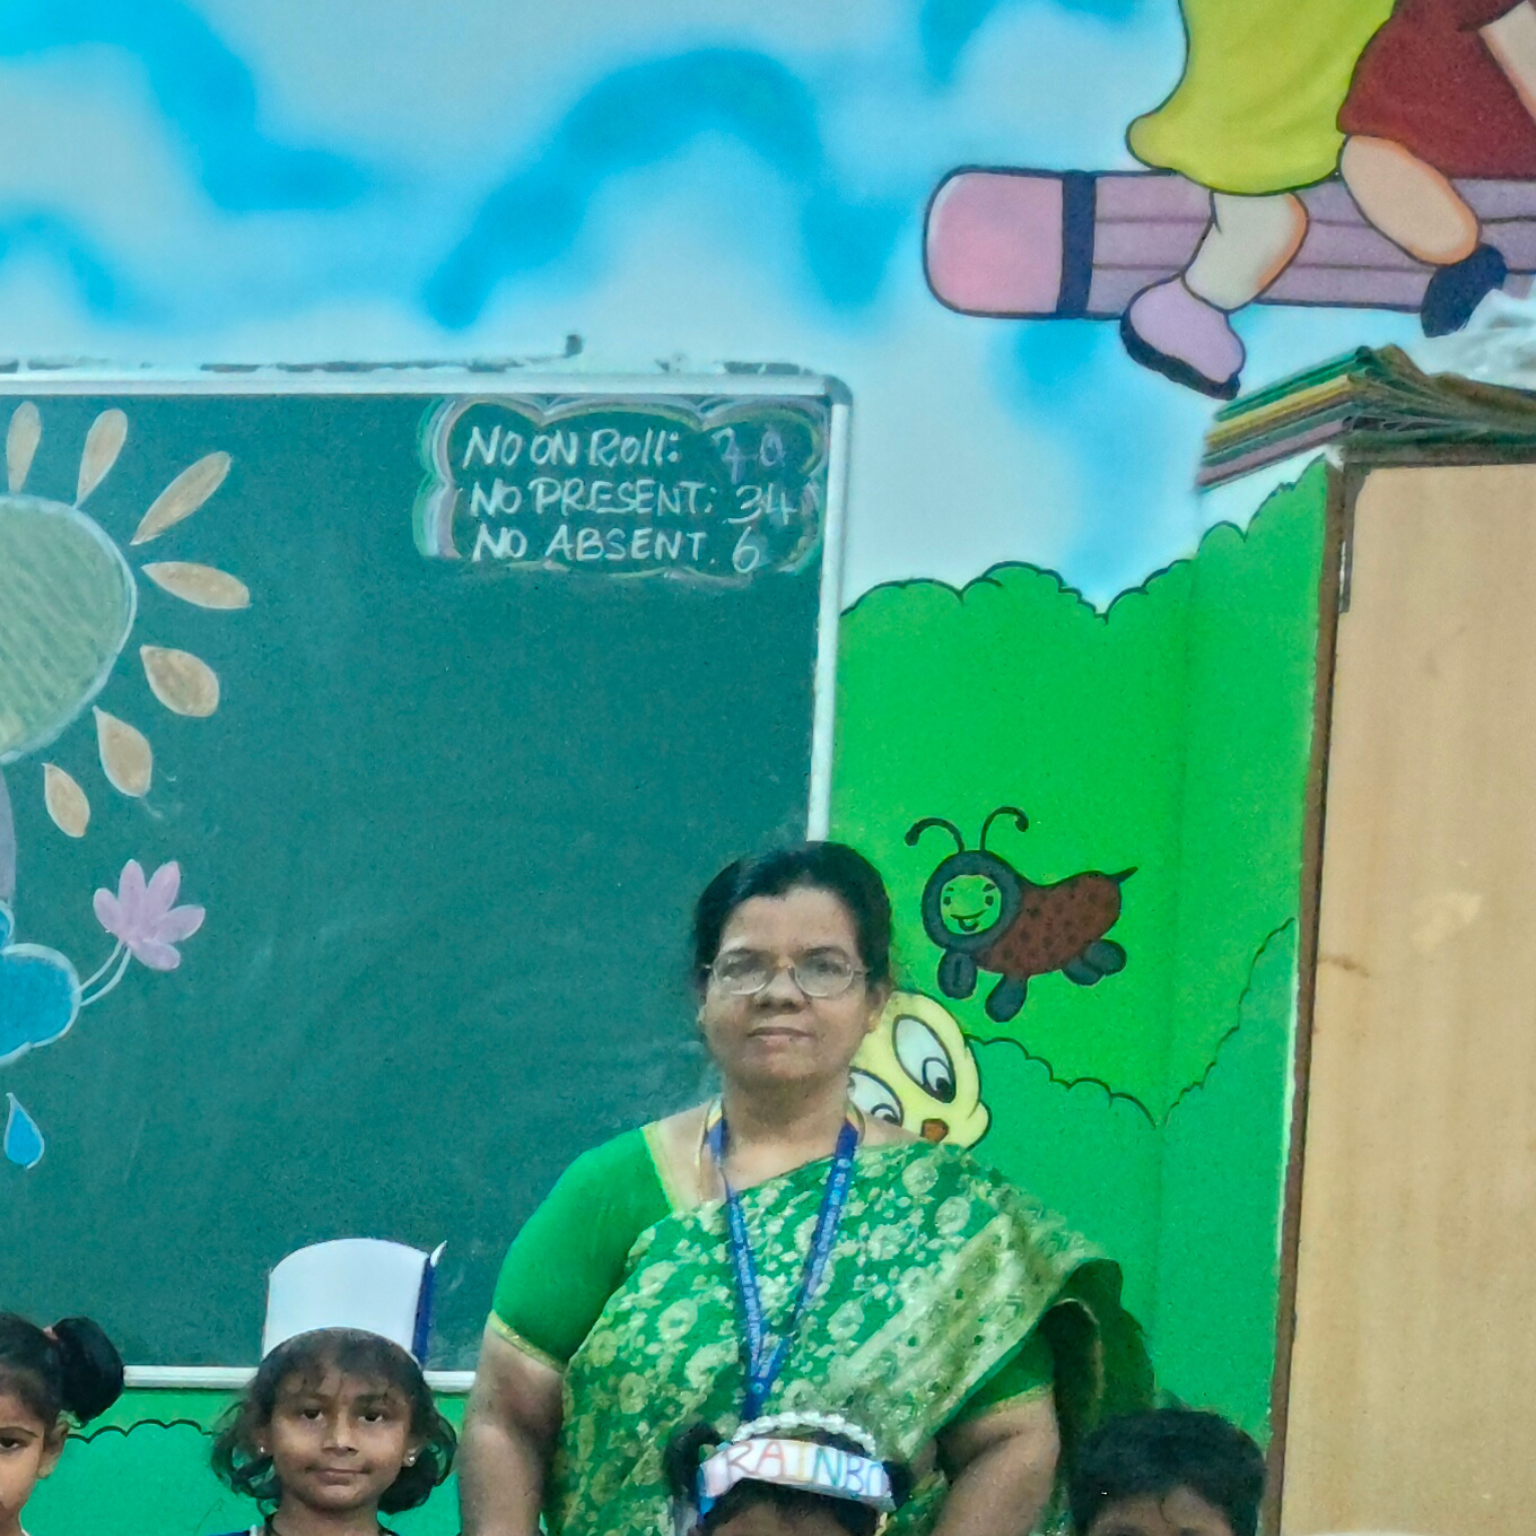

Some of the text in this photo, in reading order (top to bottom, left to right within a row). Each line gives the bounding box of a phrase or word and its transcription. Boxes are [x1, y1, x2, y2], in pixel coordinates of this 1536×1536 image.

[462, 425, 523, 468] NO
[530, 429, 577, 466] ON
[469, 478, 522, 518] NO
[723, 482, 797, 526] 34
[472, 523, 527, 562] NO
[732, 525, 760, 574] 6
